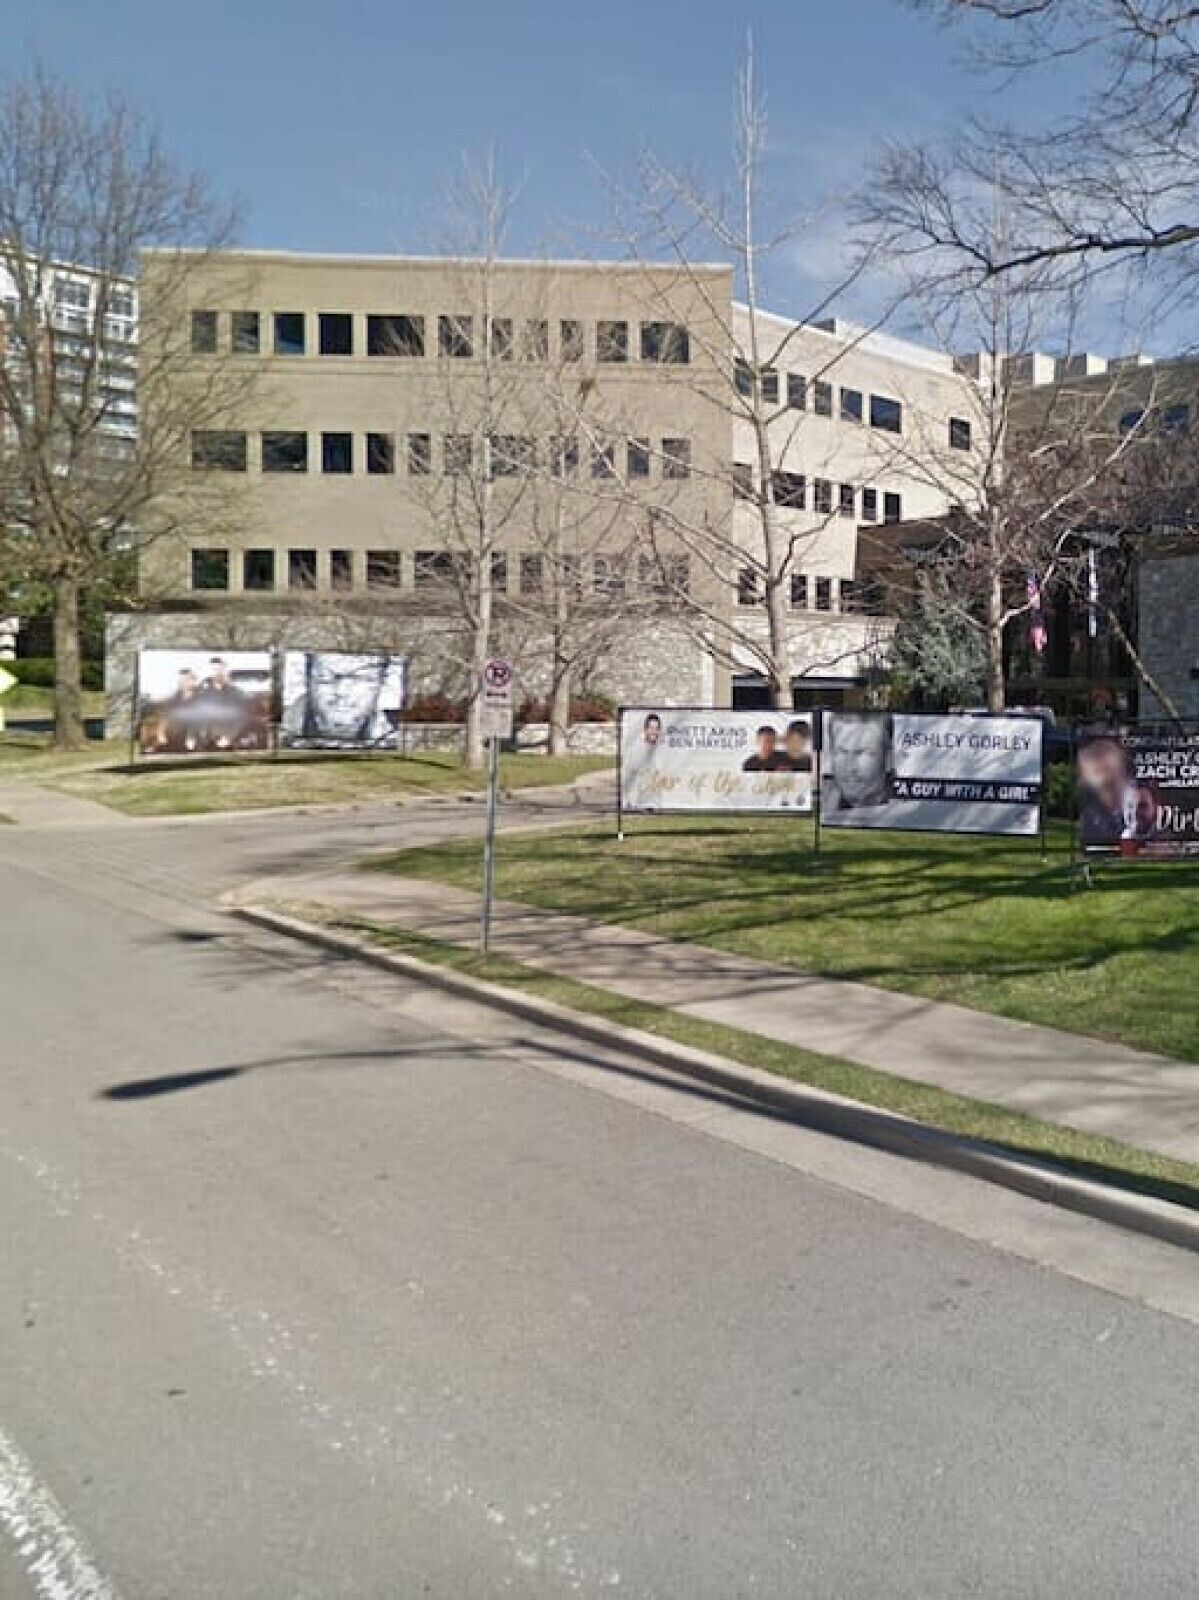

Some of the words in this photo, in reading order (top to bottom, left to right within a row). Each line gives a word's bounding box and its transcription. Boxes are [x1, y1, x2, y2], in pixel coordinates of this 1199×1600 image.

[902, 733, 964, 748] ASHLEY
[968, 734, 1031, 750] GORLEY
[1134, 751, 1191, 765] ASHLEY
[1136, 765, 1176, 778] ZACH
[911, 782, 941, 797] GUY
[983, 785, 994, 799] A
